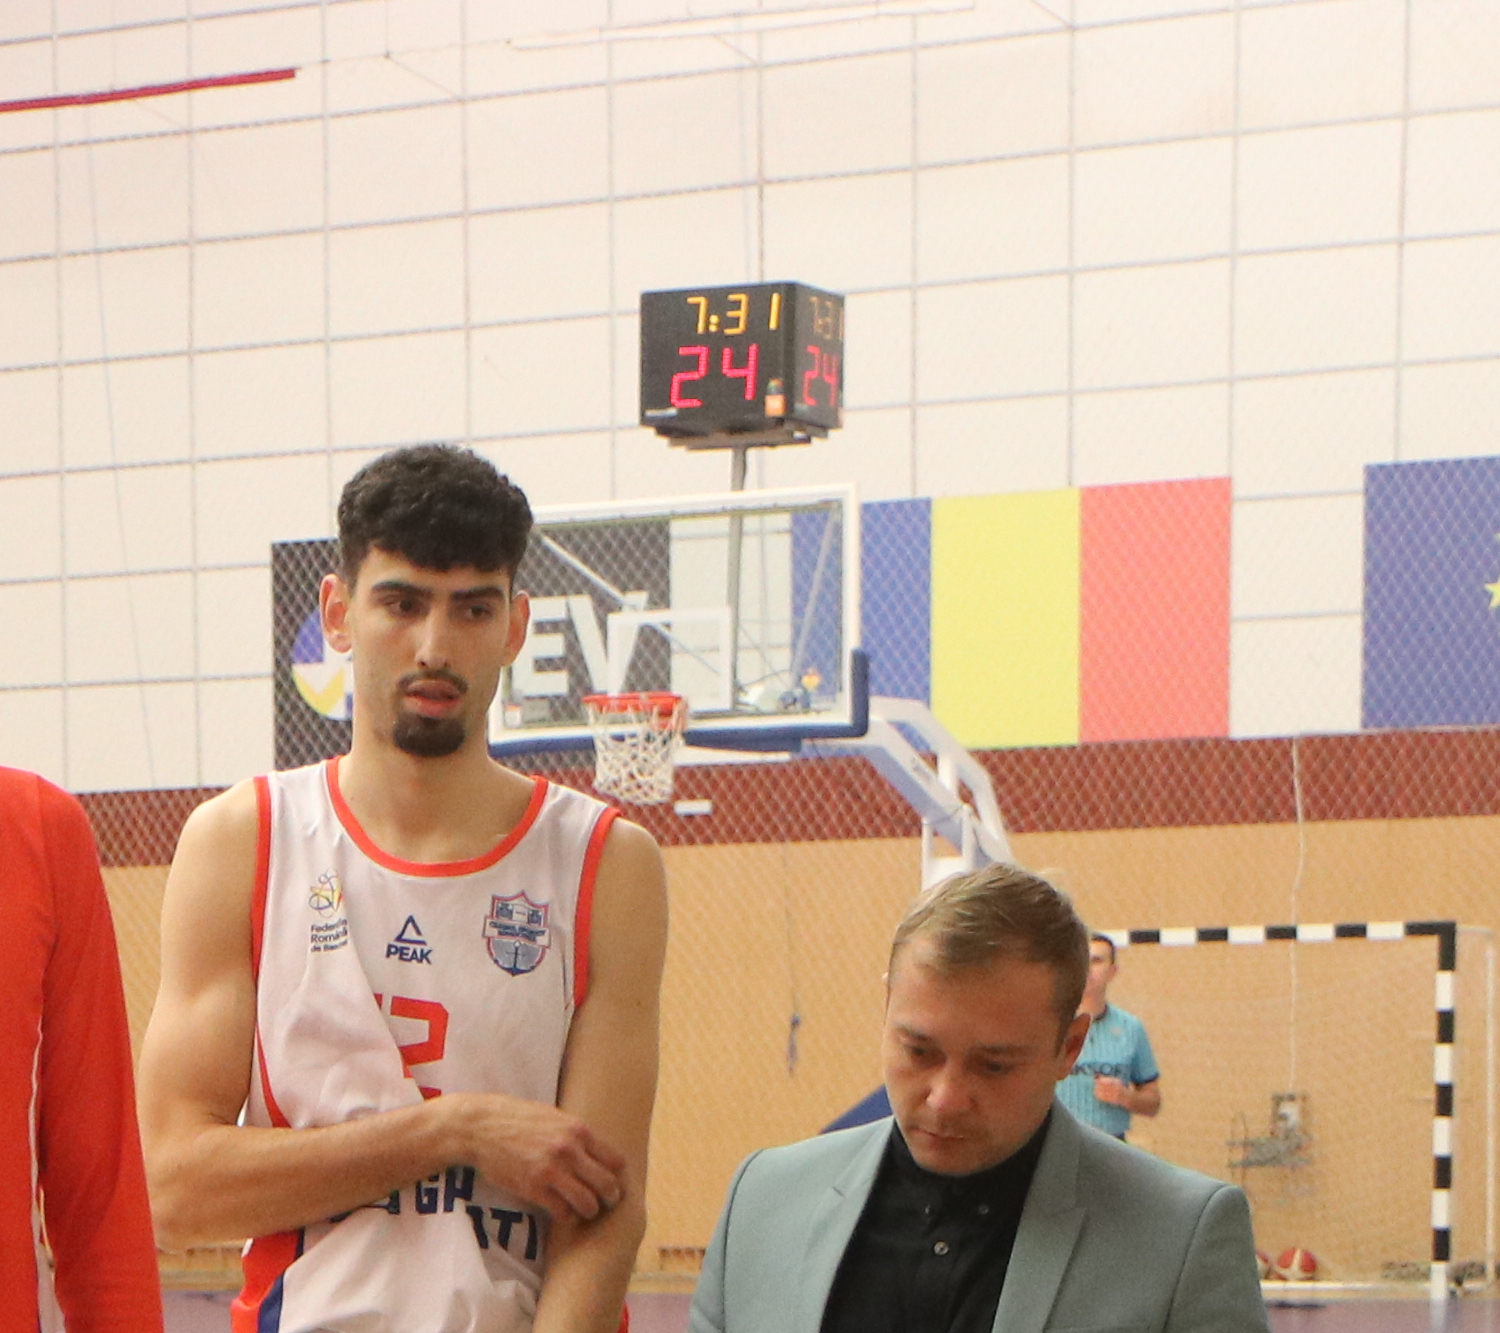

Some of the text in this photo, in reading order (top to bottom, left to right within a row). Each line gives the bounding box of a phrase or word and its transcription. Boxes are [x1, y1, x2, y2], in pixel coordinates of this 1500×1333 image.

[687, 293, 781, 334] 7:31
[670, 344, 759, 409] 24
[803, 345, 838, 407] 24
[511, 590, 650, 698] EV
[385, 943, 433, 965] PEAK
